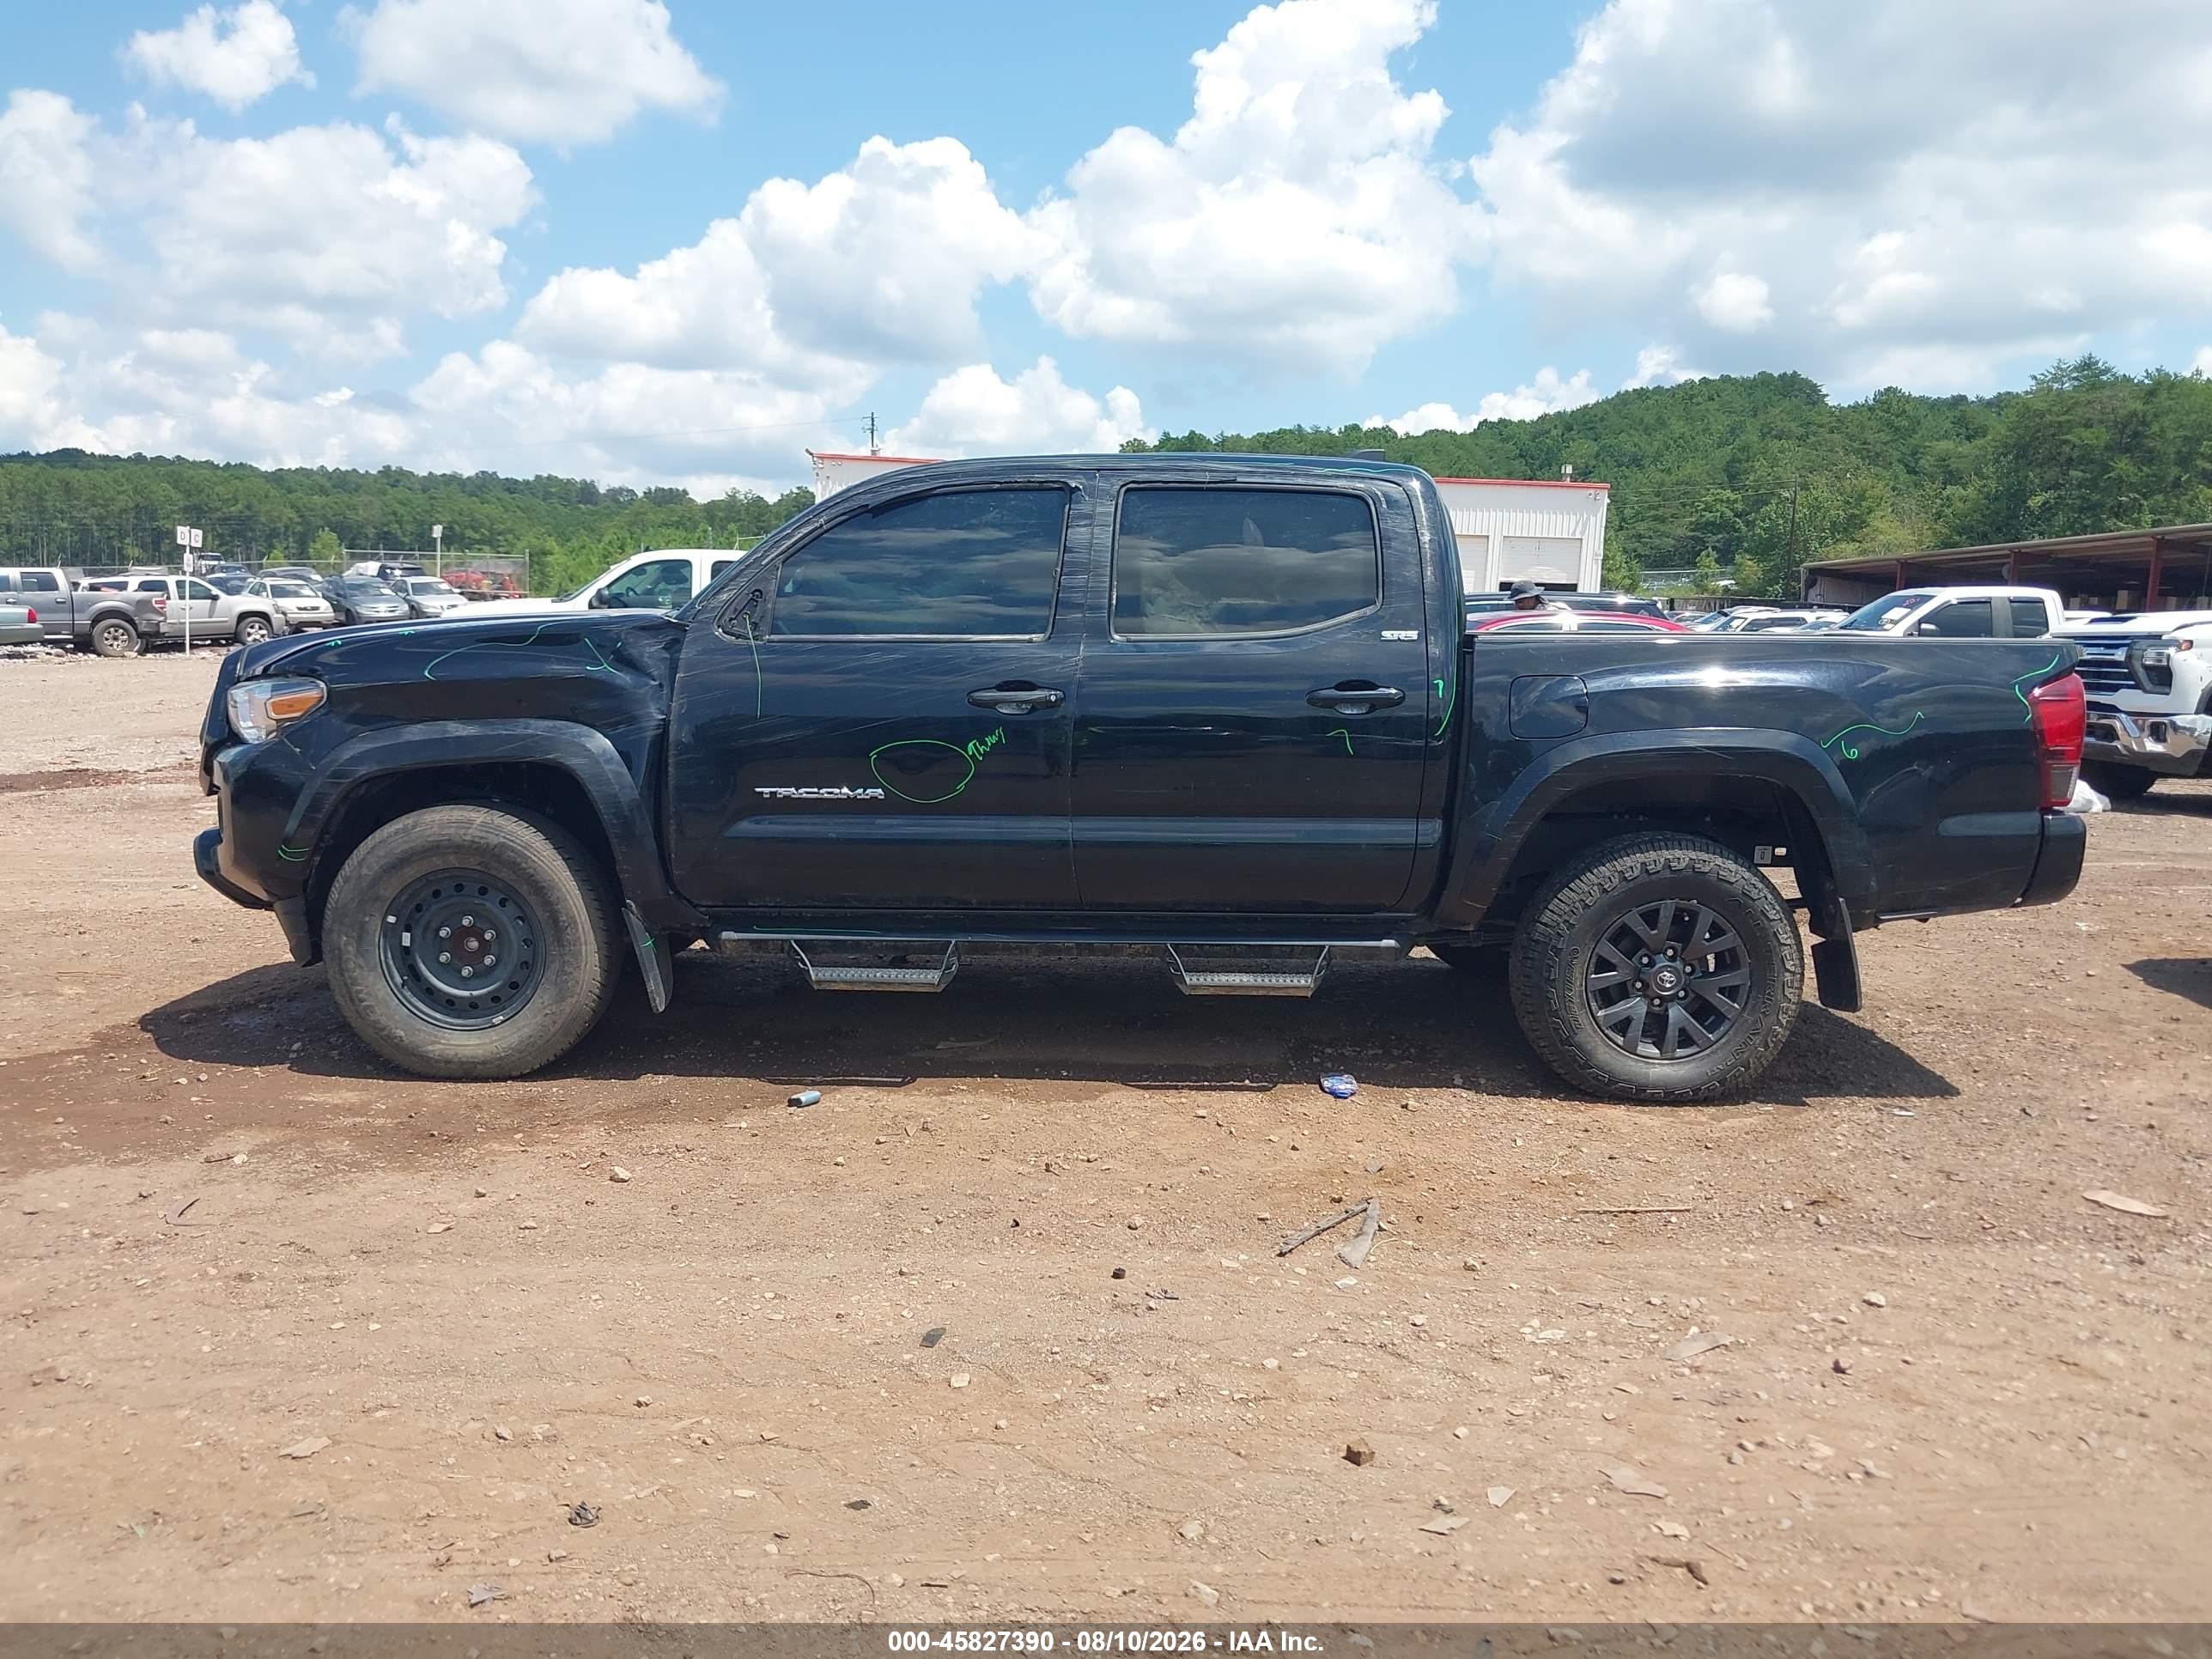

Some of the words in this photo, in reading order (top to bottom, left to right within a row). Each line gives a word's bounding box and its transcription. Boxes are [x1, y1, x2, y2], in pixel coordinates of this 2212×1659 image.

[1381, 630, 1419, 641] SR5
[1841, 740, 1858, 759] 6
[754, 785, 885, 800] TACOMA
